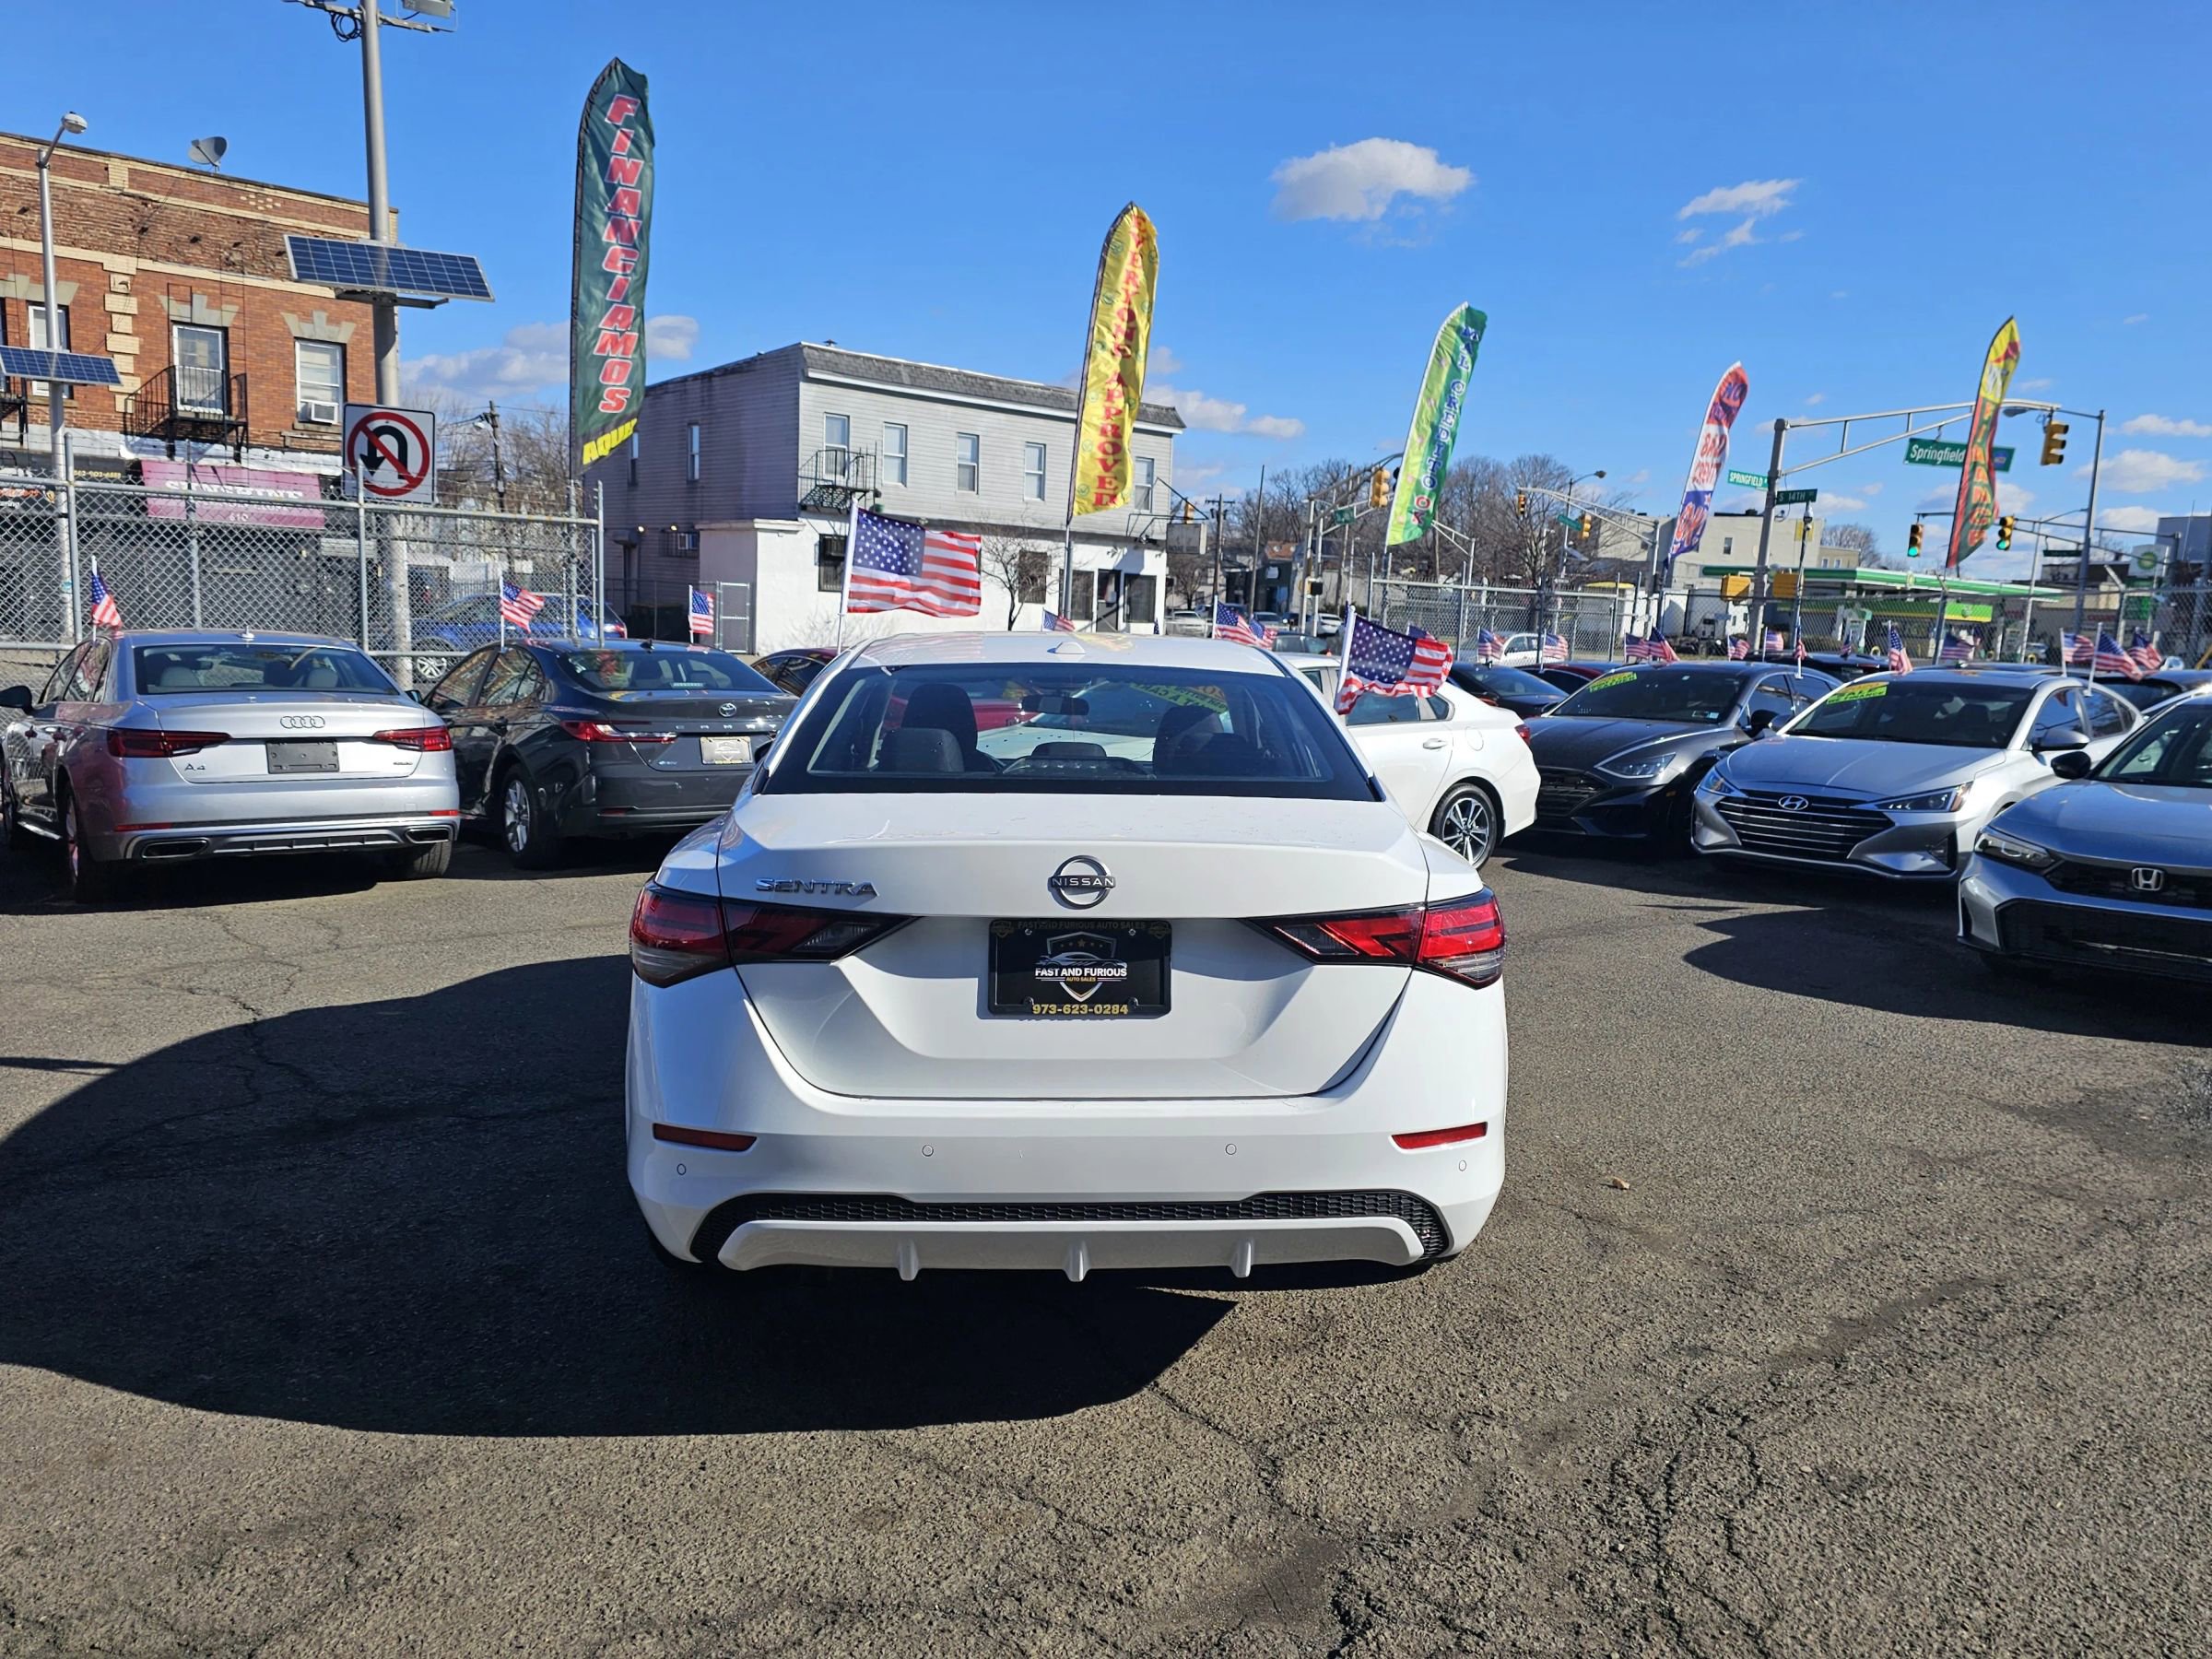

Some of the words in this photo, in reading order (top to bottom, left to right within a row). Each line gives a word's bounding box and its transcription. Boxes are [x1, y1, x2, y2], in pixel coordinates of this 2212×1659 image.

[593, 94, 644, 414] FINANCIAMOS
[1092, 369, 1127, 507] APPROVED
[1422, 379, 1465, 490] CREDITO
[1910, 444, 1966, 465] Springfield
[1729, 471, 1764, 487] SPRINGFIELD
[1788, 491, 1806, 500] 14TH
[1410, 495, 1432, 526] OK
[183, 762, 207, 771] A4
[755, 877, 880, 897] SENTRA
[1051, 877, 1115, 887] NISSAN
[1018, 921, 1038, 930] FAST
[1059, 921, 1095, 930] FURIOUS
[1097, 921, 1118, 930] AUTO
[1120, 921, 1146, 930] SALES
[1035, 968, 1059, 977] FAST
[1061, 968, 1082, 977] AND
[1084, 968, 1127, 977] FURIOUS
[1032, 1004, 1129, 1015] 973-623-0284
